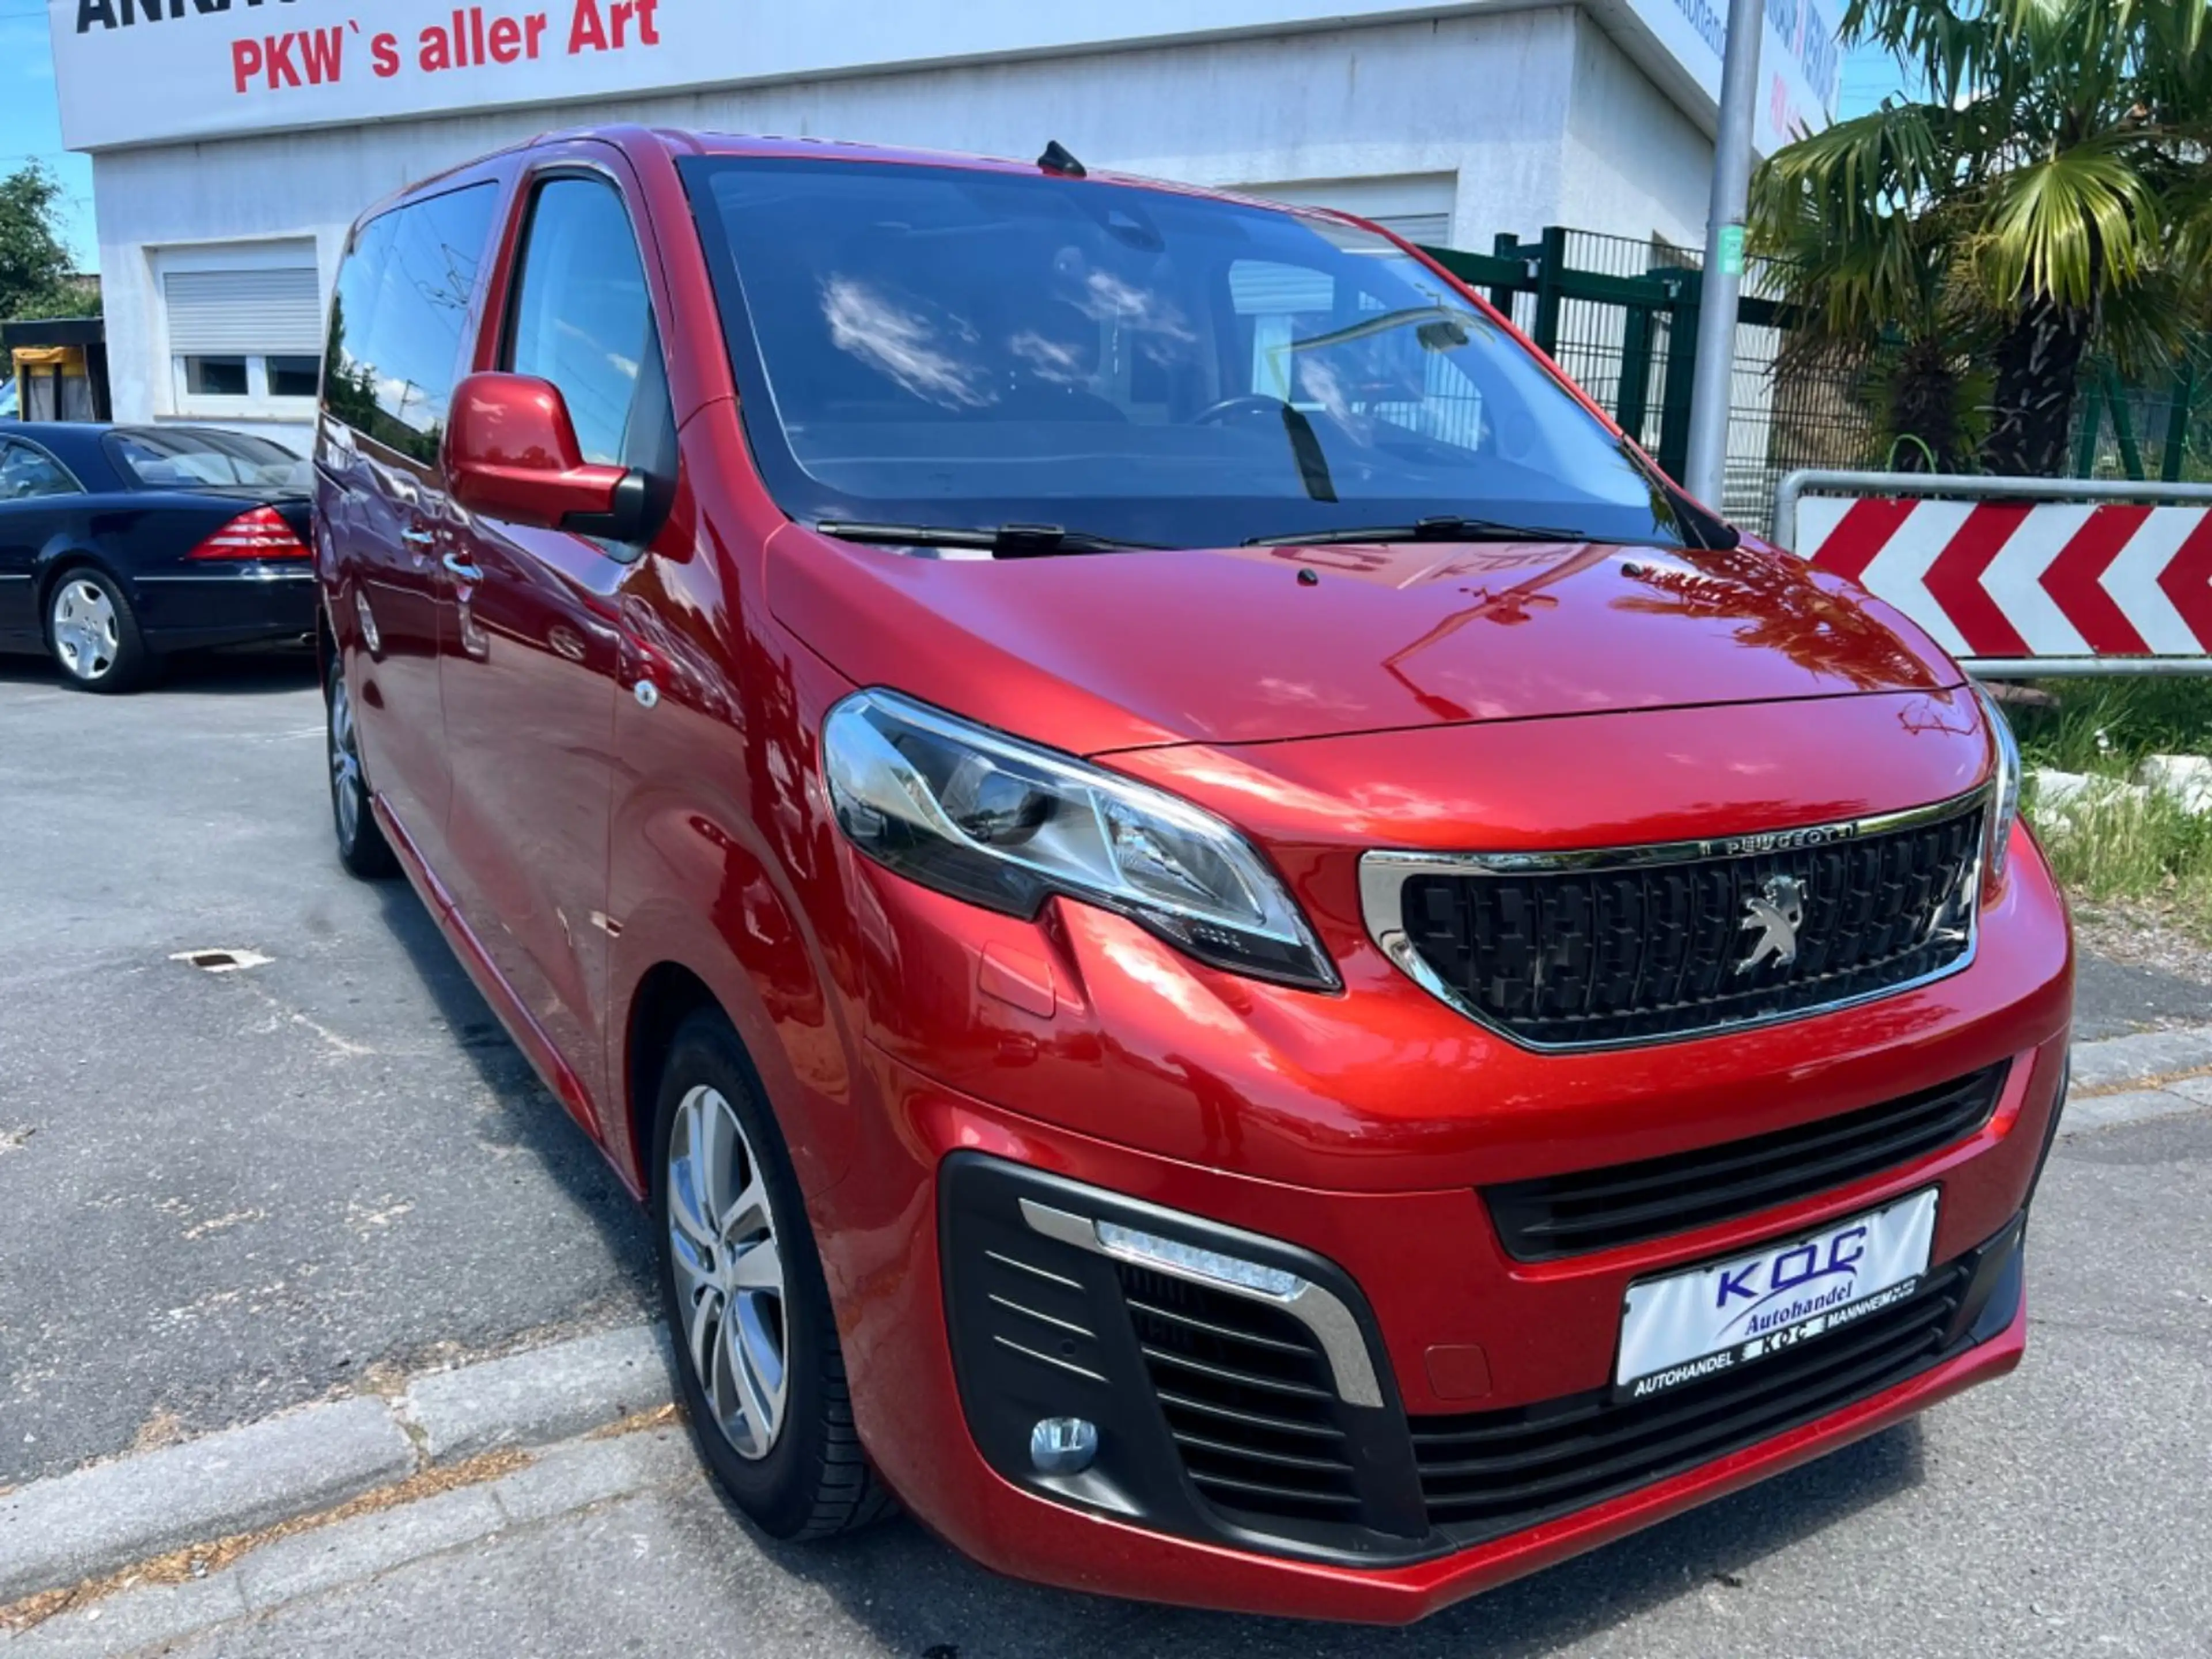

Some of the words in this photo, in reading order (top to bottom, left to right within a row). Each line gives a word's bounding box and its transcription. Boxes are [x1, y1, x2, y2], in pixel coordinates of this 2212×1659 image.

[419, 7, 547, 73] aller
[568, 0, 659, 54] Art
[1728, 827, 1837, 855] PEUGEOT
[1745, 1280, 1854, 1336] Autohandel
[1634, 1351, 1734, 1397] AUTOHANDEL
